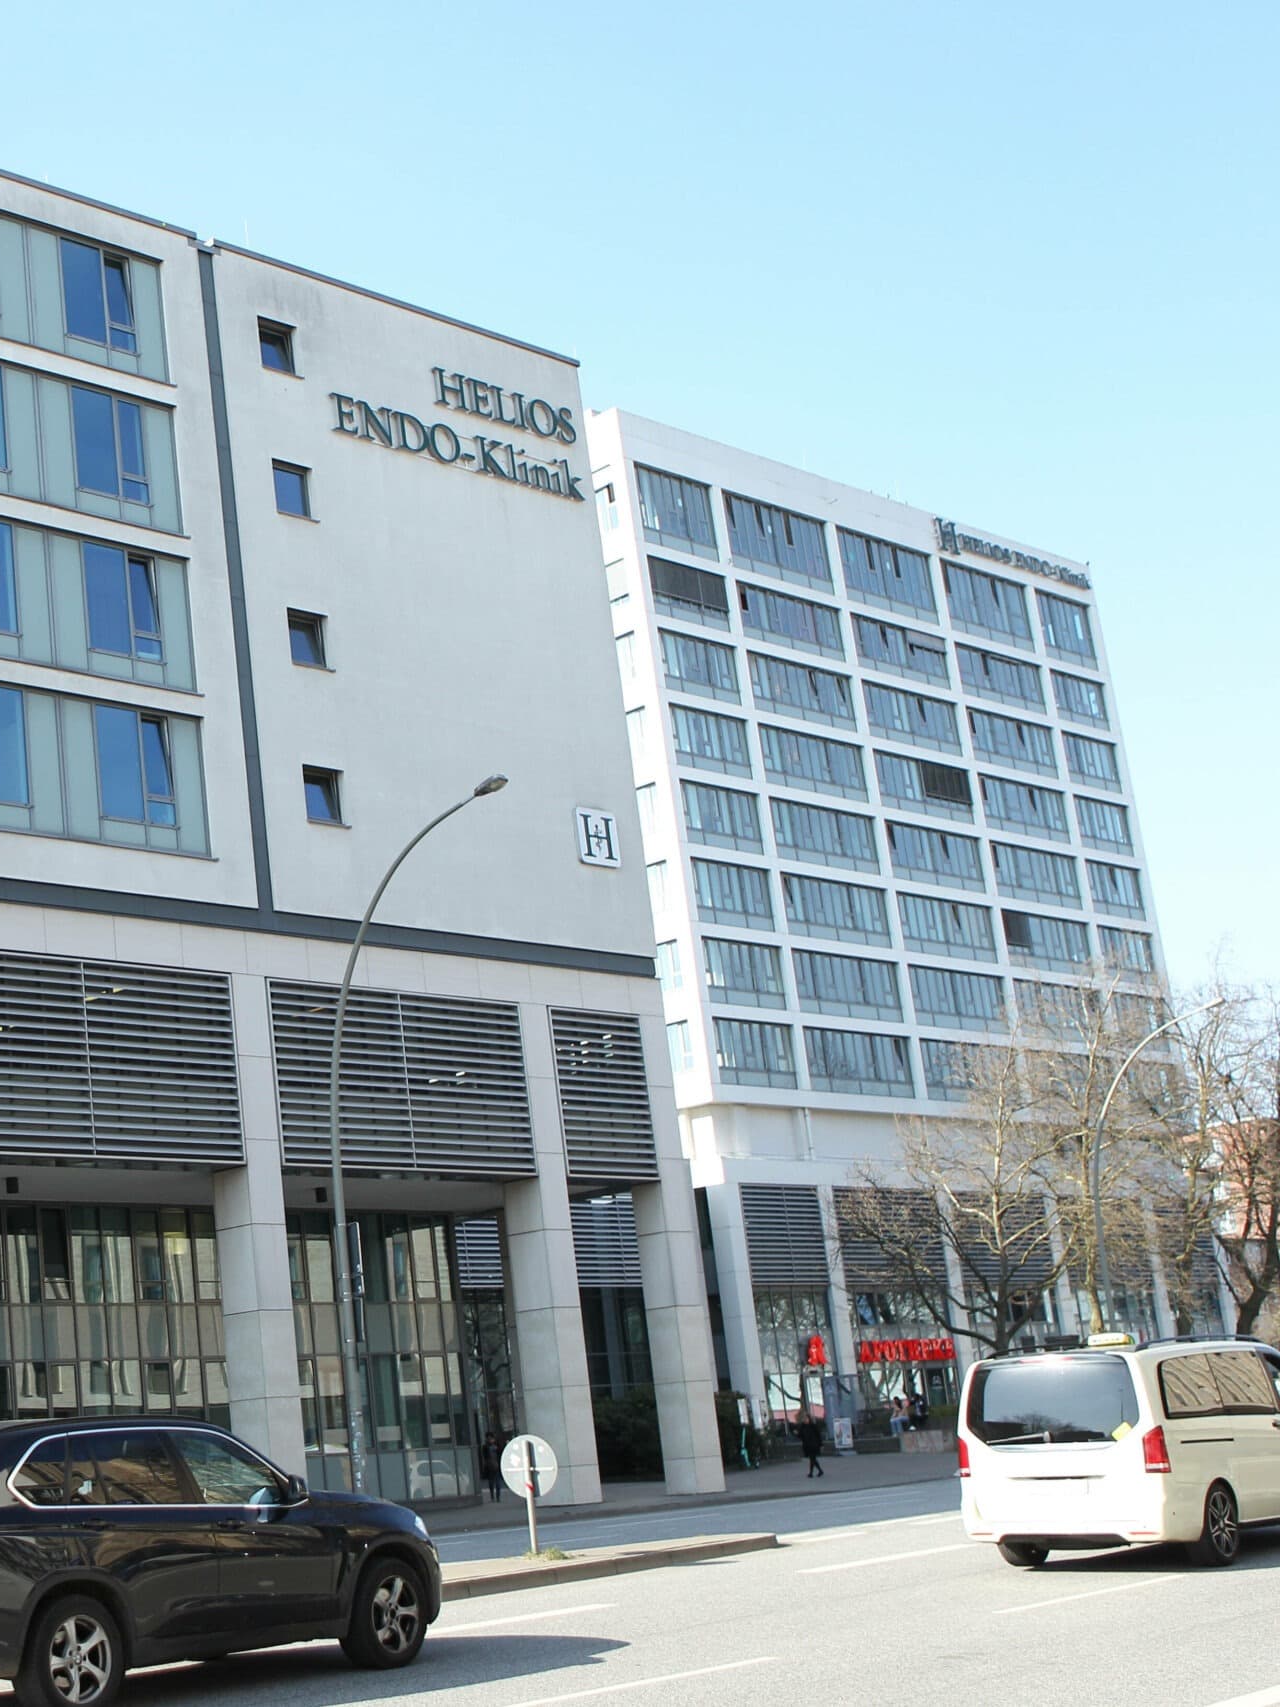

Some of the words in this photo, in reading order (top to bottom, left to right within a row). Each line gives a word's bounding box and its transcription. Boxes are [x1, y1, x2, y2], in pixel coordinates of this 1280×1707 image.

[431, 366, 577, 445] HELIOS
[329, 392, 585, 502] ENDO-Klinik
[958, 533, 1011, 564] HELIOS
[579, 813, 618, 861] H
[858, 1338, 957, 1363] APOTHEKE
